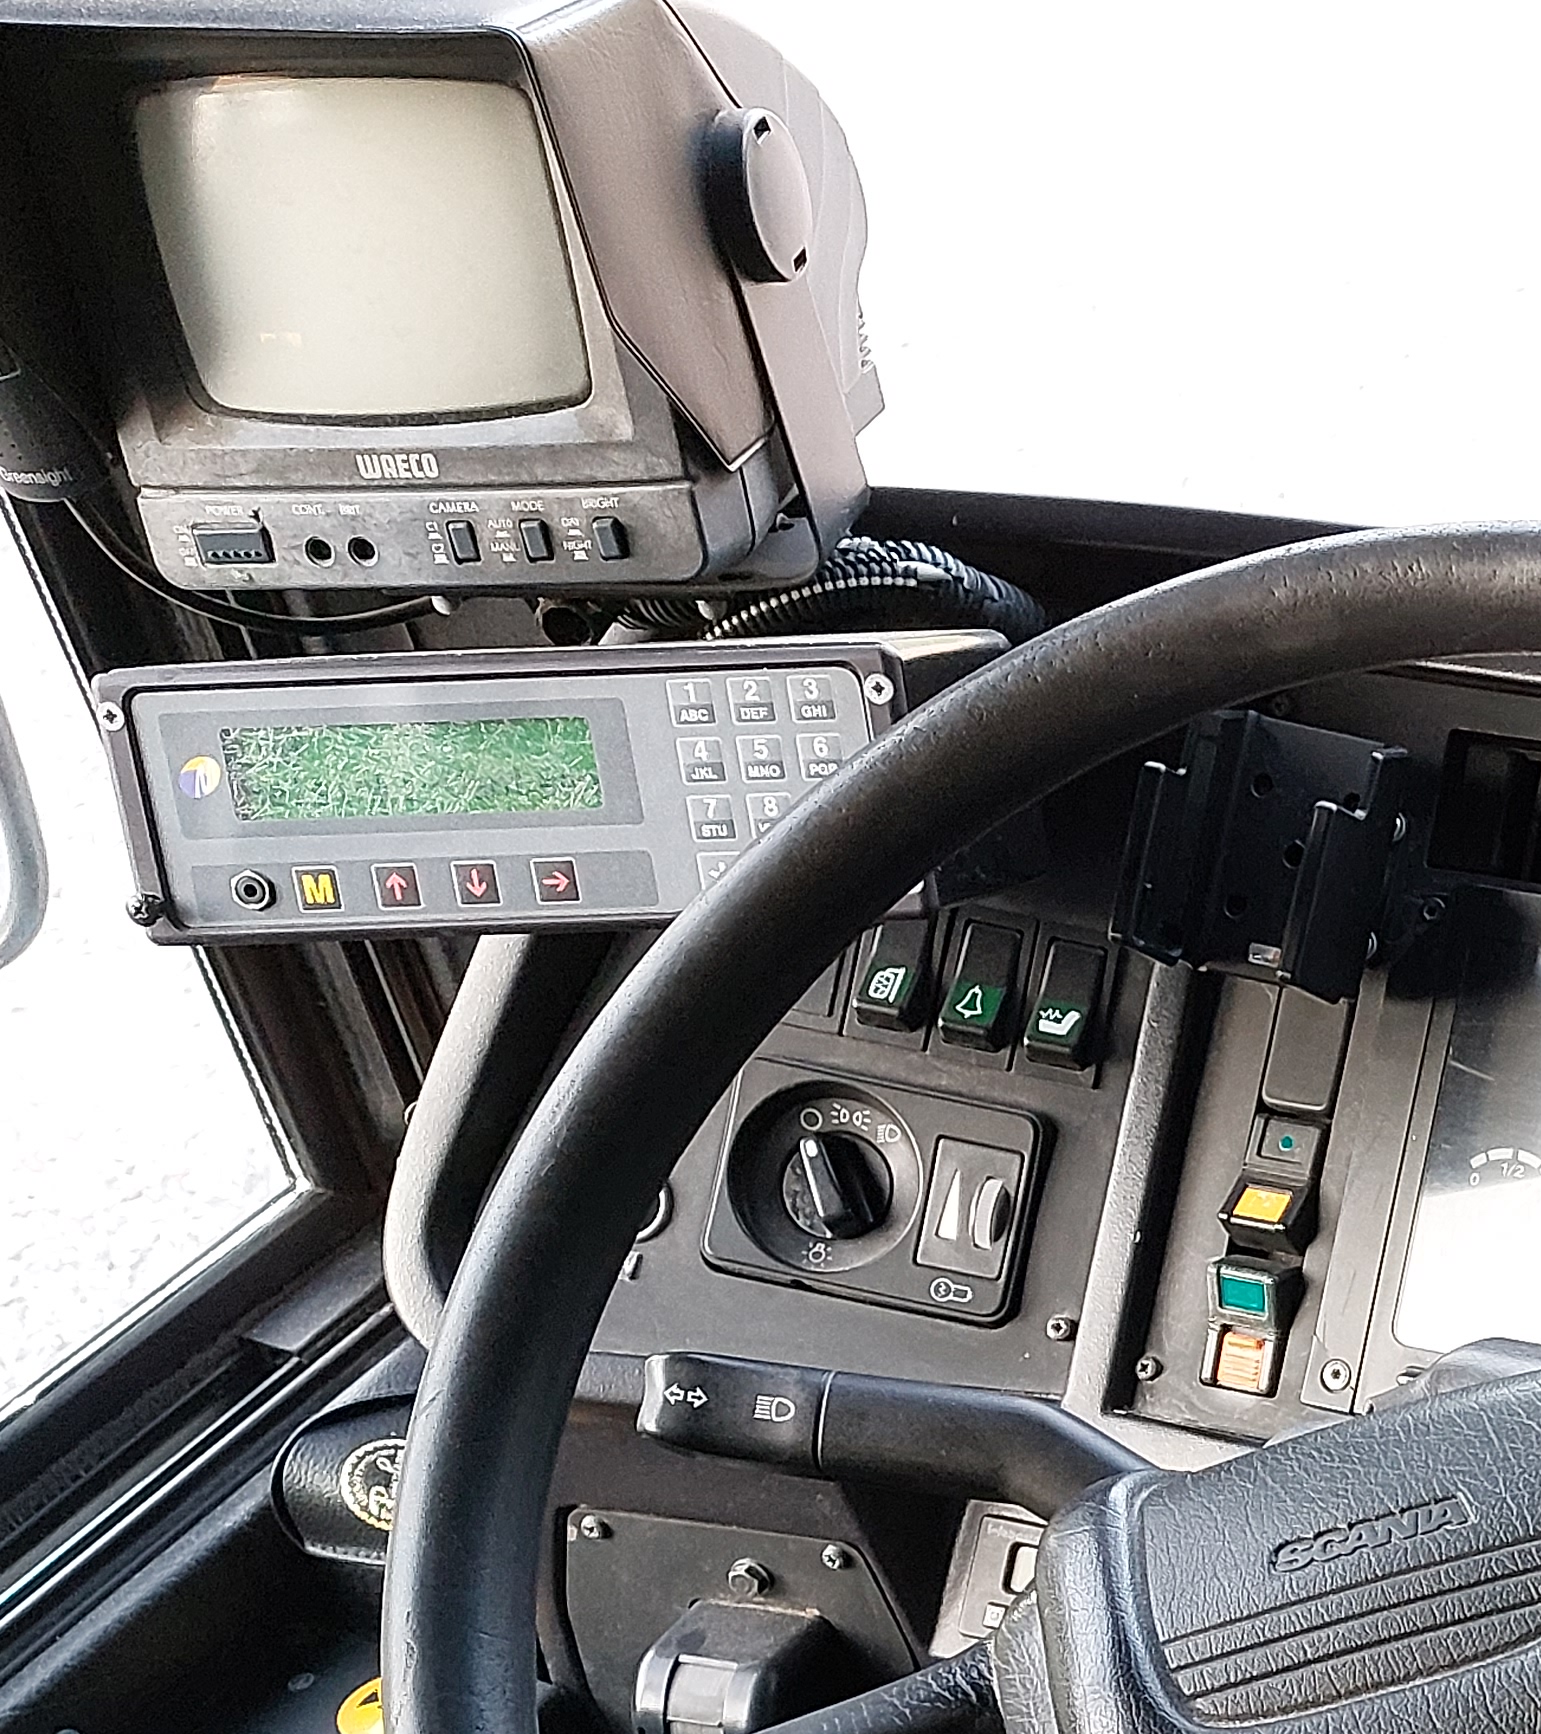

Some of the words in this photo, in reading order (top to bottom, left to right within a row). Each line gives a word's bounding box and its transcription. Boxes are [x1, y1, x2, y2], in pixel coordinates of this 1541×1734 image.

[355, 452, 439, 480] WAECO
[206, 504, 244, 516] POWER
[429, 501, 479, 514] CAMERA
[511, 500, 545, 512] MODE
[488, 519, 513, 529] AUTO
[683, 681, 697, 703] 1
[743, 680, 760, 701] 2
[803, 678, 819, 700] 3
[679, 707, 709, 722] ABC
[740, 706, 768, 720] DEF
[801, 704, 827, 718] GHI
[693, 741, 708, 761] 4
[753, 739, 769, 760] 5
[813, 737, 829, 758] 6
[690, 767, 718, 780] JKL
[748, 765, 781, 778] MNO
[702, 798, 717, 819] 7
[763, 797, 779, 817] 8
[701, 825, 728, 838] STU
[301, 874, 336, 905] M
[1501, 1162, 1526, 1179] 1/2
[1469, 1172, 1480, 1187] 0
[1273, 1495, 1477, 1572] SCANIA
